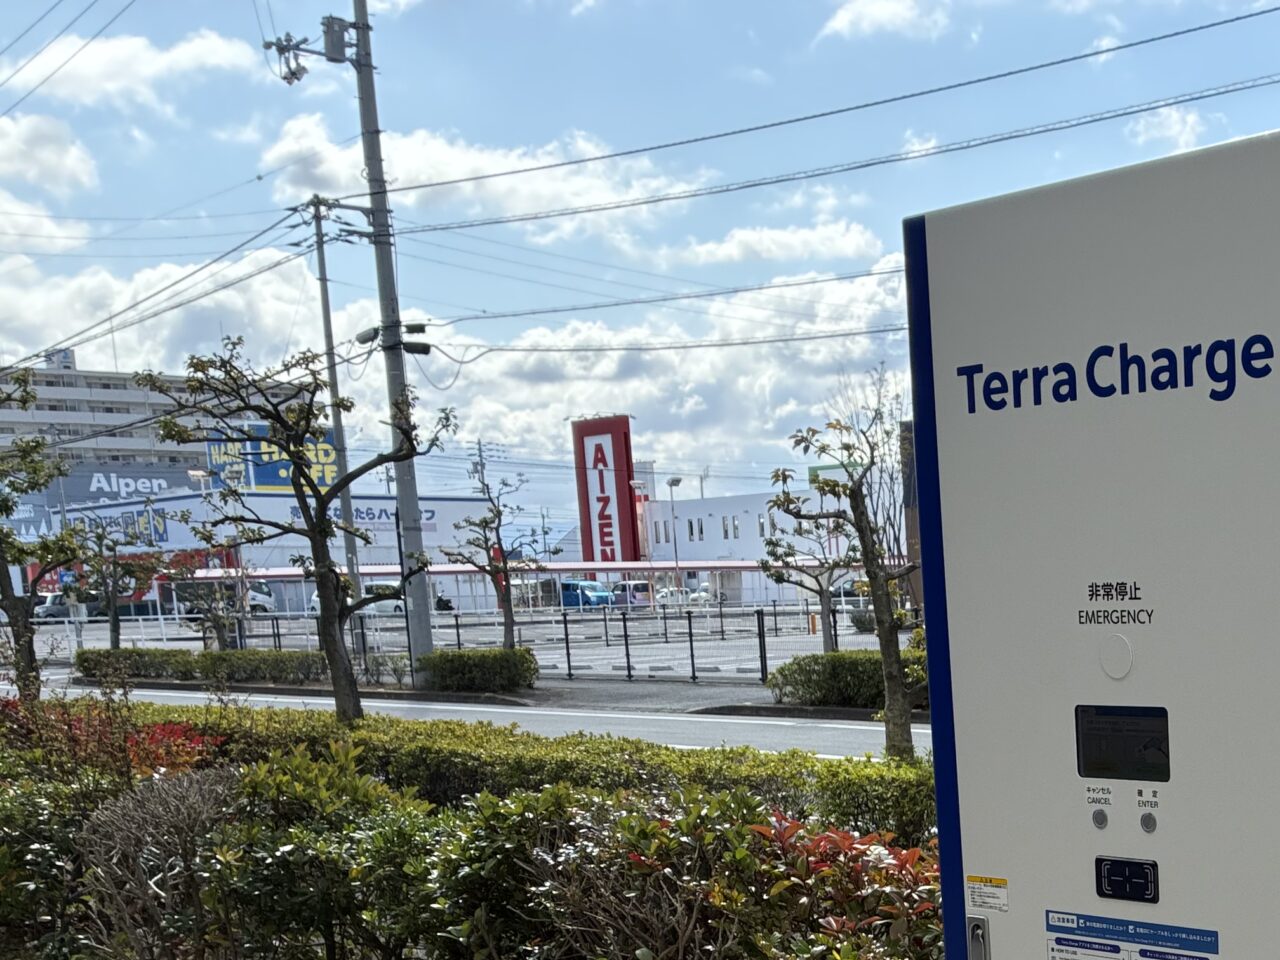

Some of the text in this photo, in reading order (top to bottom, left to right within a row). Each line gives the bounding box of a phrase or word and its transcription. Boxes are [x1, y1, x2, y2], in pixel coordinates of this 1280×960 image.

[956, 334, 1275, 414] Terra Charge
[89, 472, 168, 498] Alpen
[1088, 581, 1142, 602] 非常停止
[1078, 608, 1154, 625] EMERGENCY
[1087, 796, 1112, 806] CANCEL
[1138, 800, 1159, 809] ENTER
